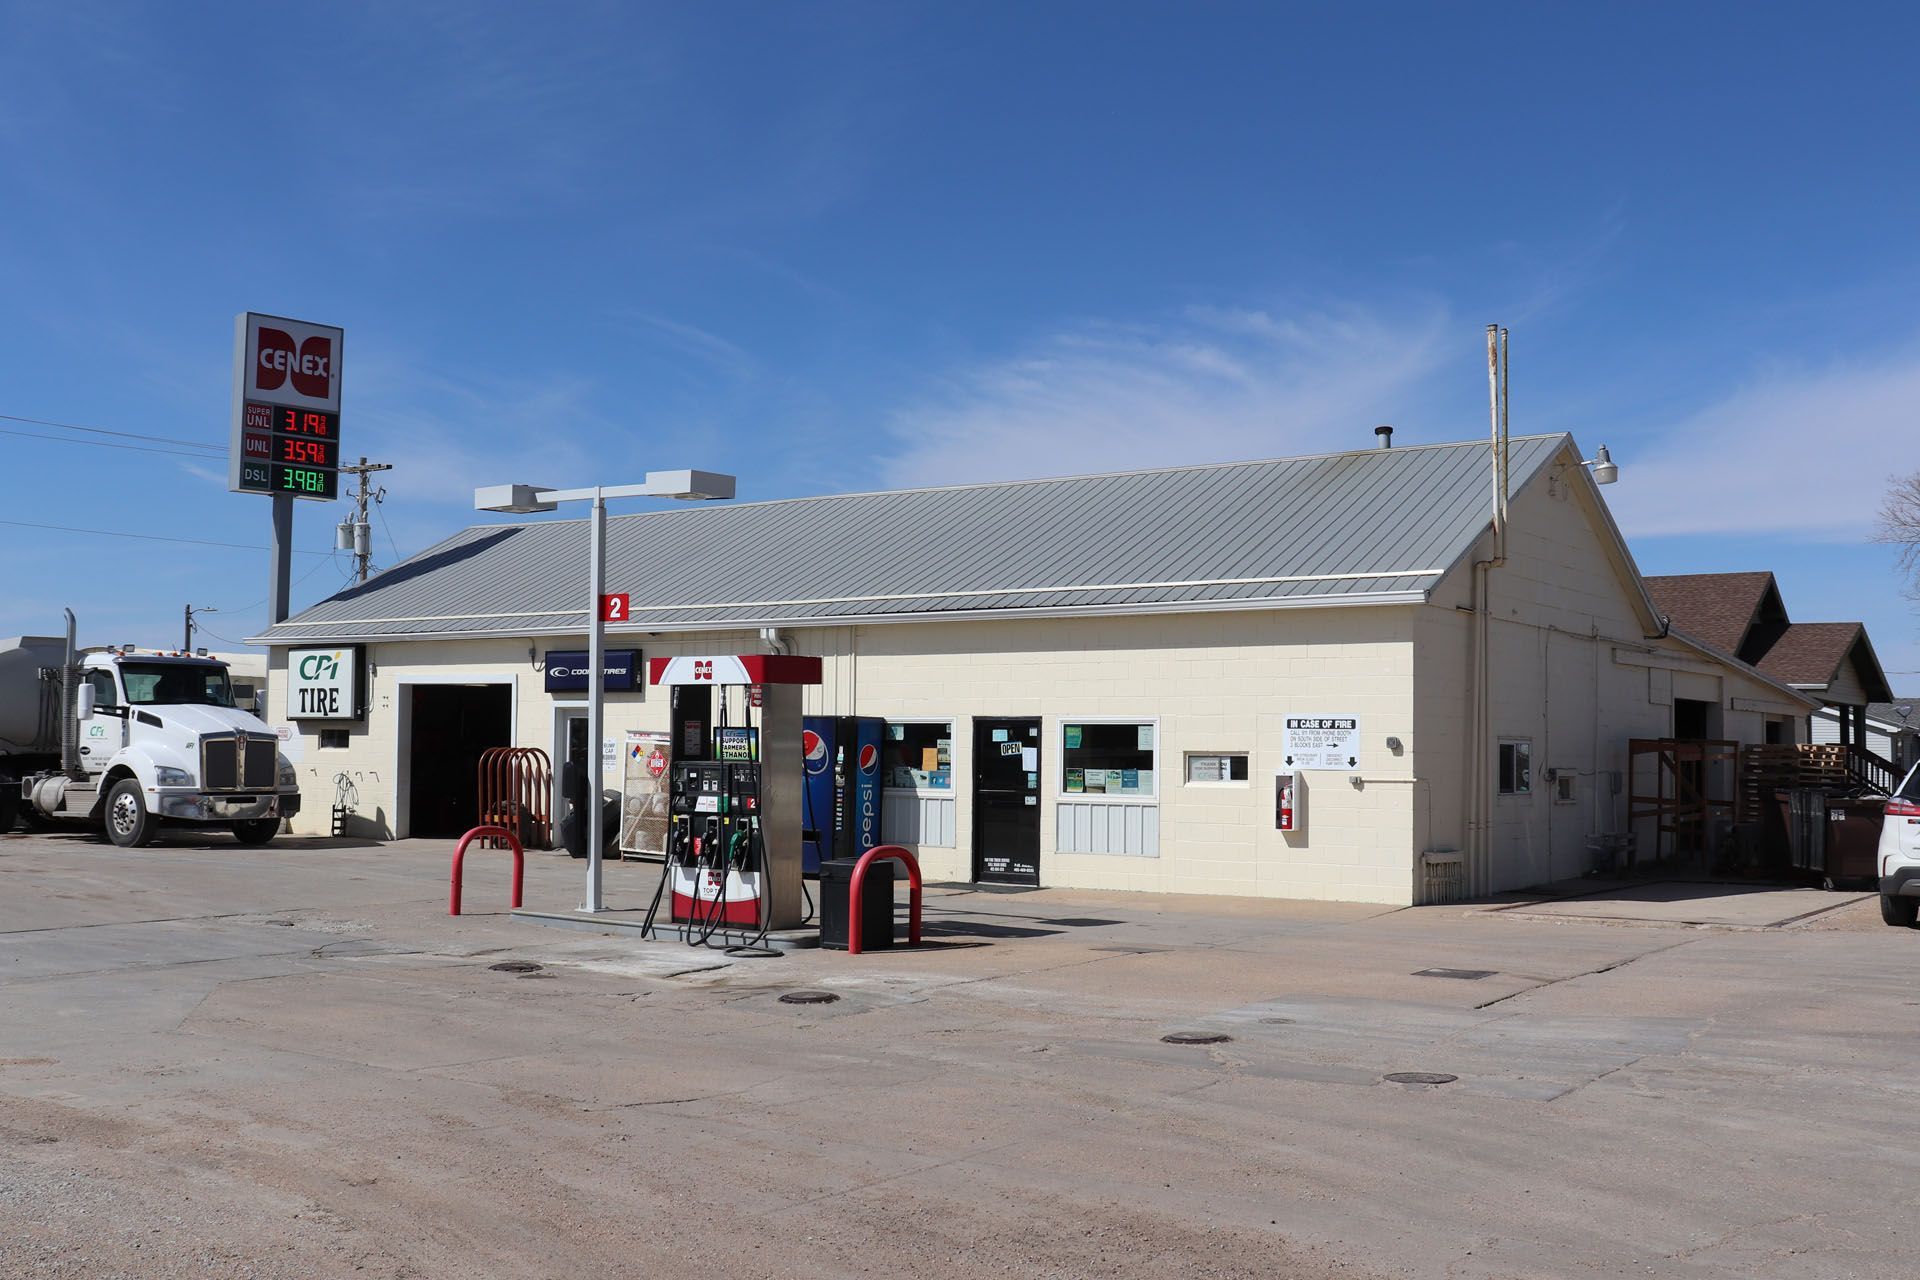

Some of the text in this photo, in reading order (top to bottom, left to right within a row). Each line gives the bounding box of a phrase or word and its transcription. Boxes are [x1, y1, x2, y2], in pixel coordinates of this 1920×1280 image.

[259, 348, 328, 378] CENEX
[247, 405, 271, 416] SUPER
[247, 414, 270, 428] UNL
[246, 438, 269, 454] UNL
[244, 468, 267, 482] DSL
[283, 468, 317, 492] 3.98
[609, 597, 621, 618] 2
[299, 687, 339, 716] TIRE
[1290, 720, 1352, 729] IN CASE OF FIRE
[1002, 742, 1021, 755] OPEN
[750, 798, 757, 809] 2
[862, 784, 875, 848] pepsi
